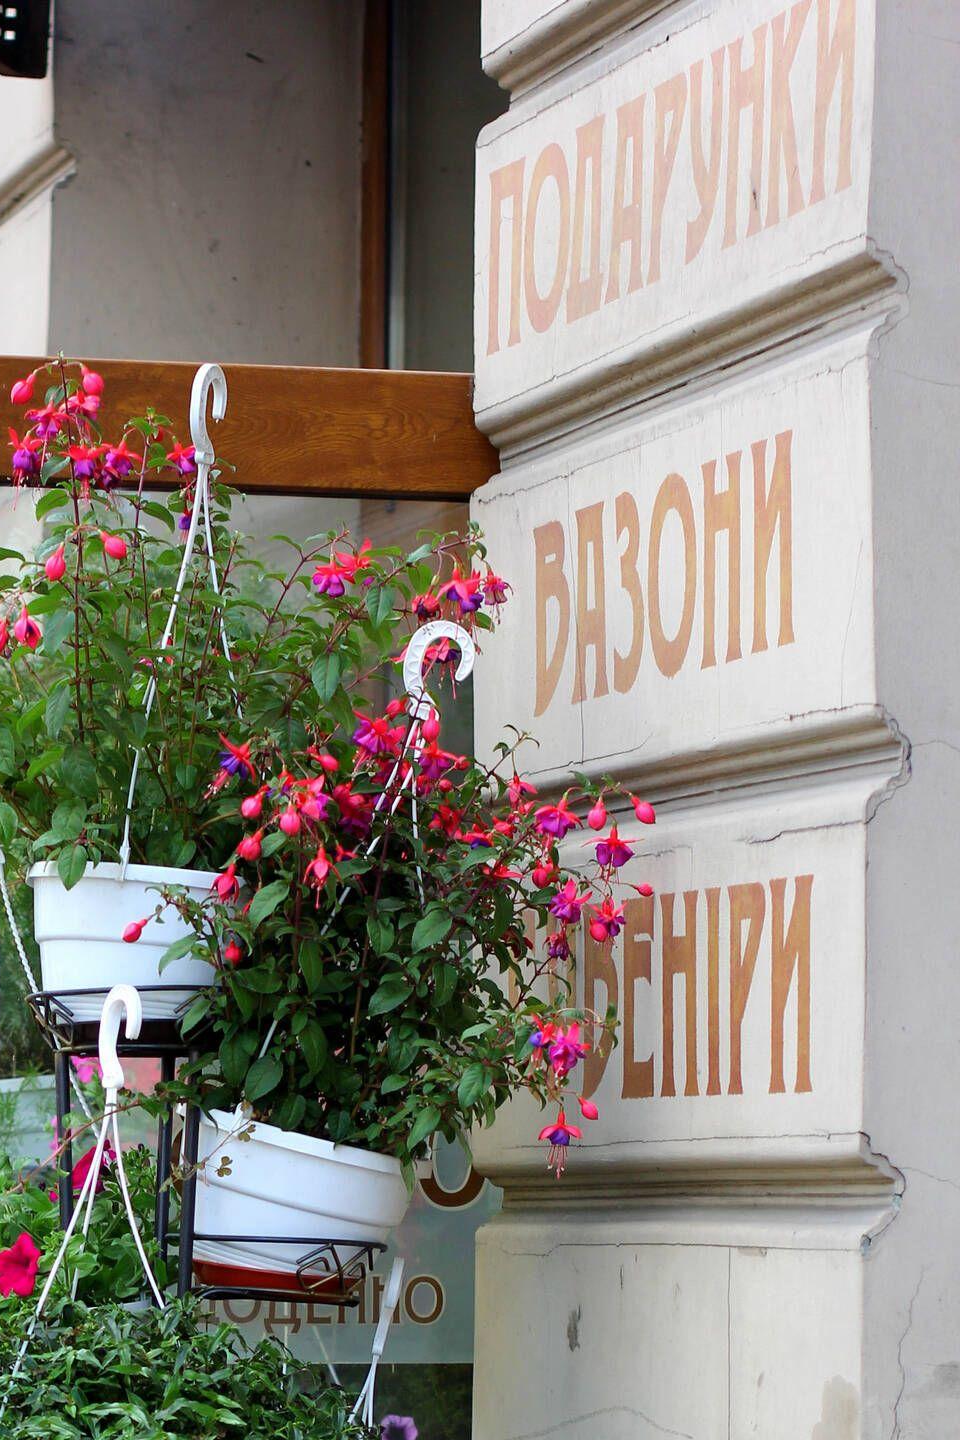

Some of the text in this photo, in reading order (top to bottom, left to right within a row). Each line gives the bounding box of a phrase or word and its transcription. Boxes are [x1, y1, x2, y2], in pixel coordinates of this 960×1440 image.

[486, 0, 856, 357] ПОДАРУНКИ
[533, 429, 795, 717] ВАЗОНИ
[193, 1275, 444, 1334] ОДЕННО
